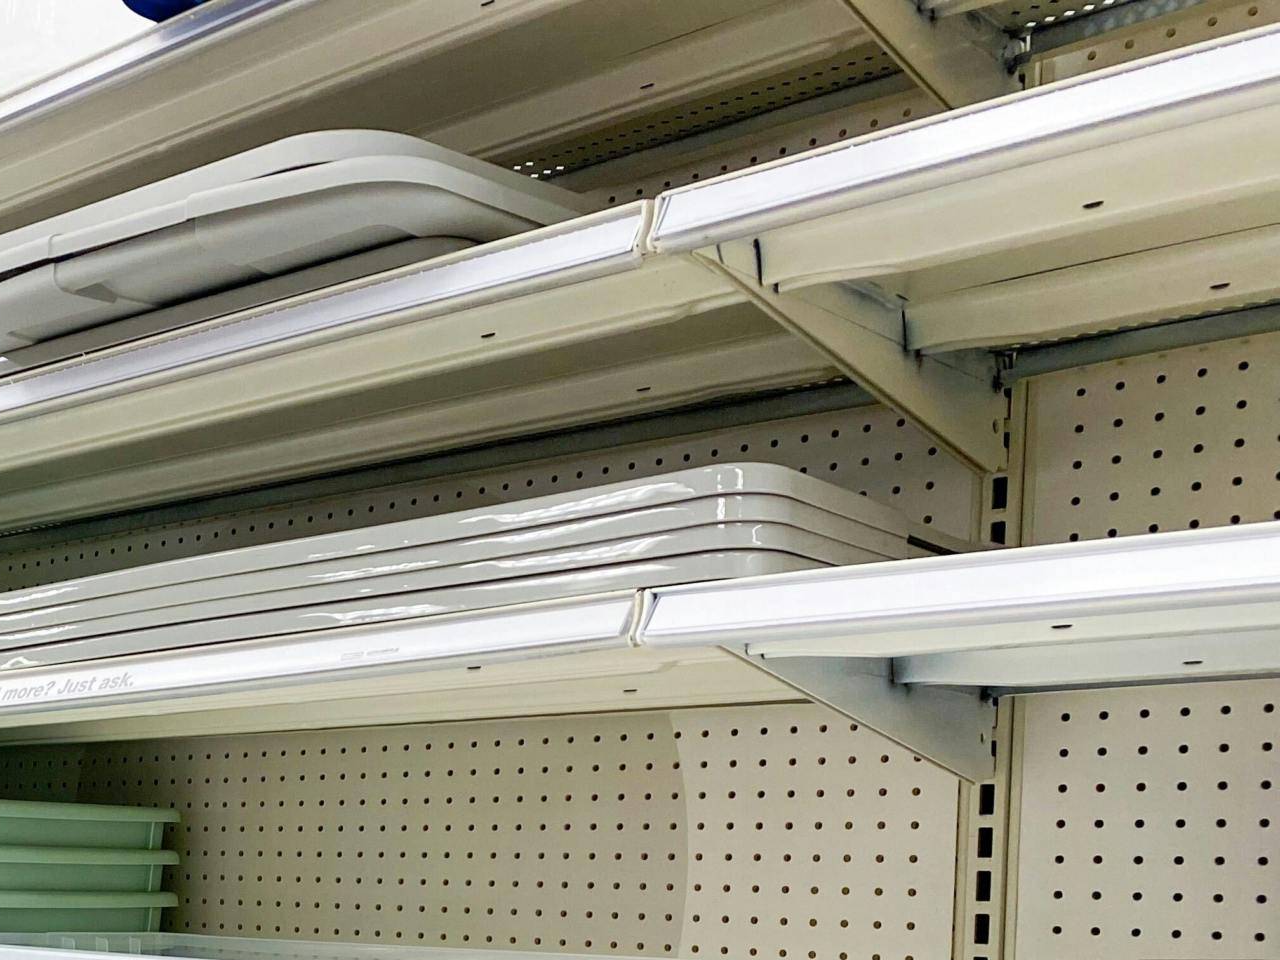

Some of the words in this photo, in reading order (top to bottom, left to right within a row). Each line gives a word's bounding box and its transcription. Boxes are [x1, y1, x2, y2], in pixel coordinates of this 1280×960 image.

[2, 681, 56, 700] more?
[57, 676, 97, 694] Just
[98, 672, 134, 690] ask.
